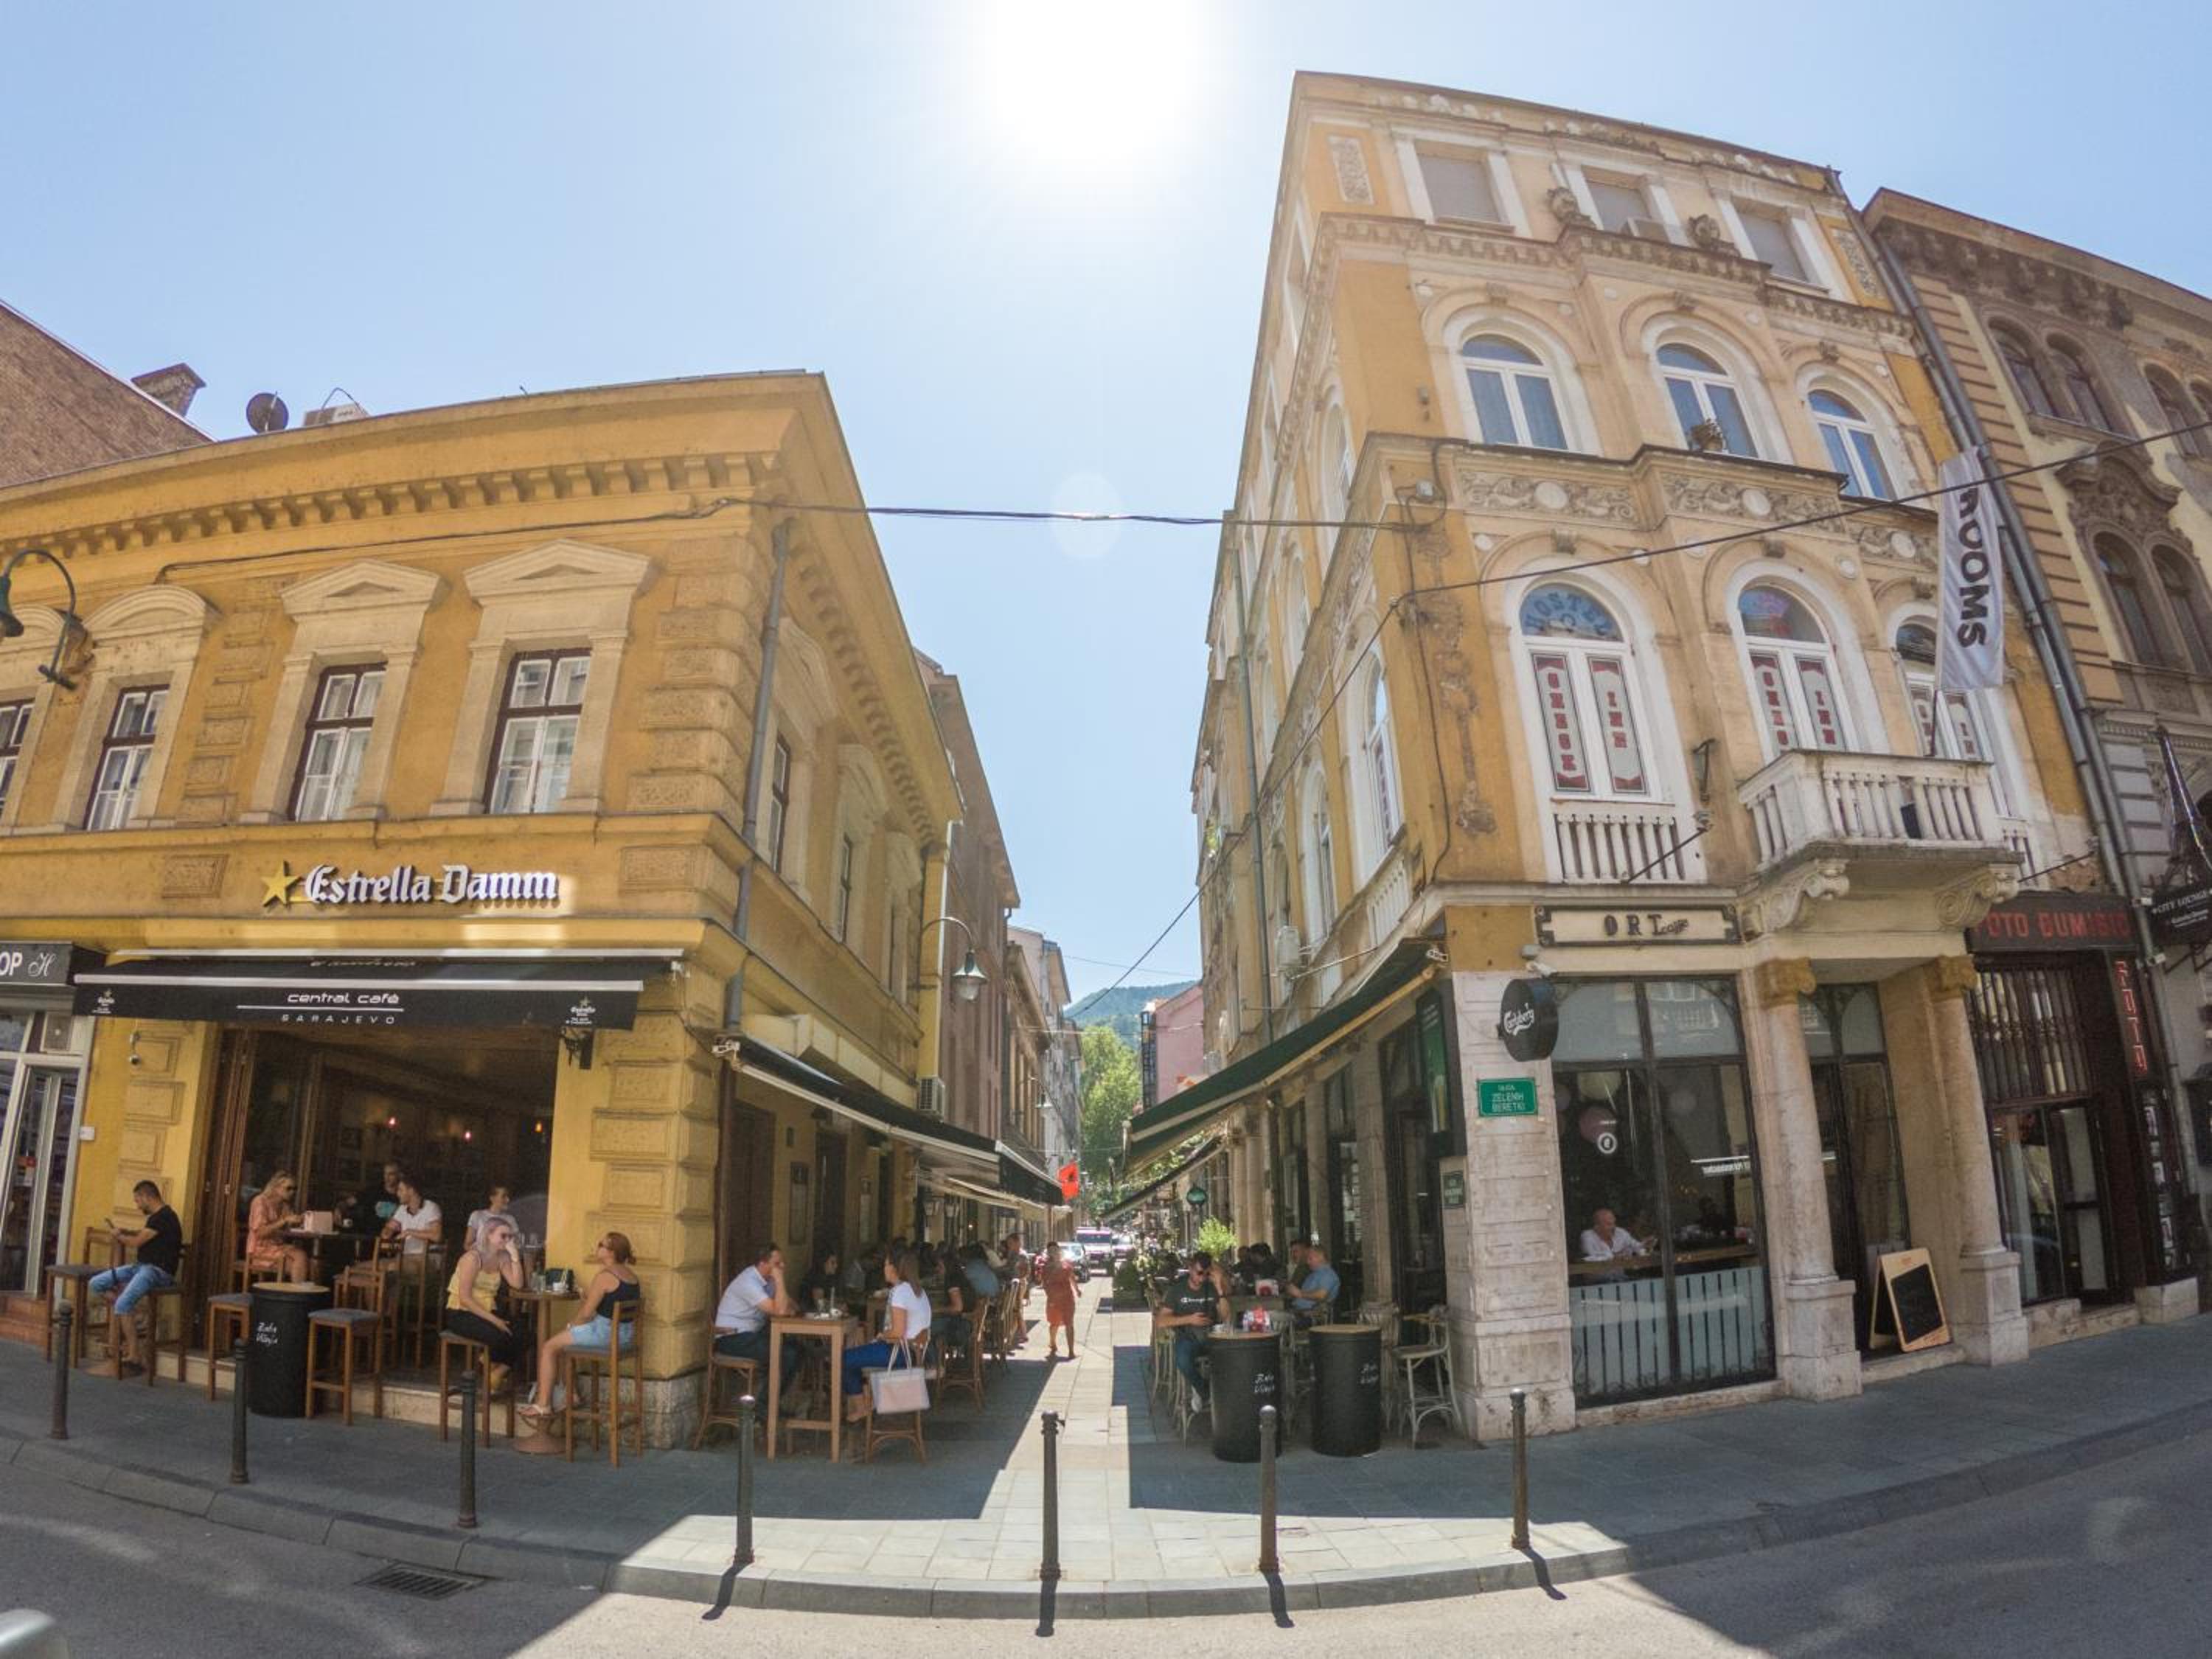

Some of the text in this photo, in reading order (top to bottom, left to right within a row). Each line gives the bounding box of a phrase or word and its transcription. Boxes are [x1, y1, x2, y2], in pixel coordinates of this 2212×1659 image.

[304, 864, 560, 904] Estrella Damm
[287, 993, 350, 1004] central
[281, 1014, 395, 1025] SARAJEVO
[2115, 961, 2148, 1074] FOTO
